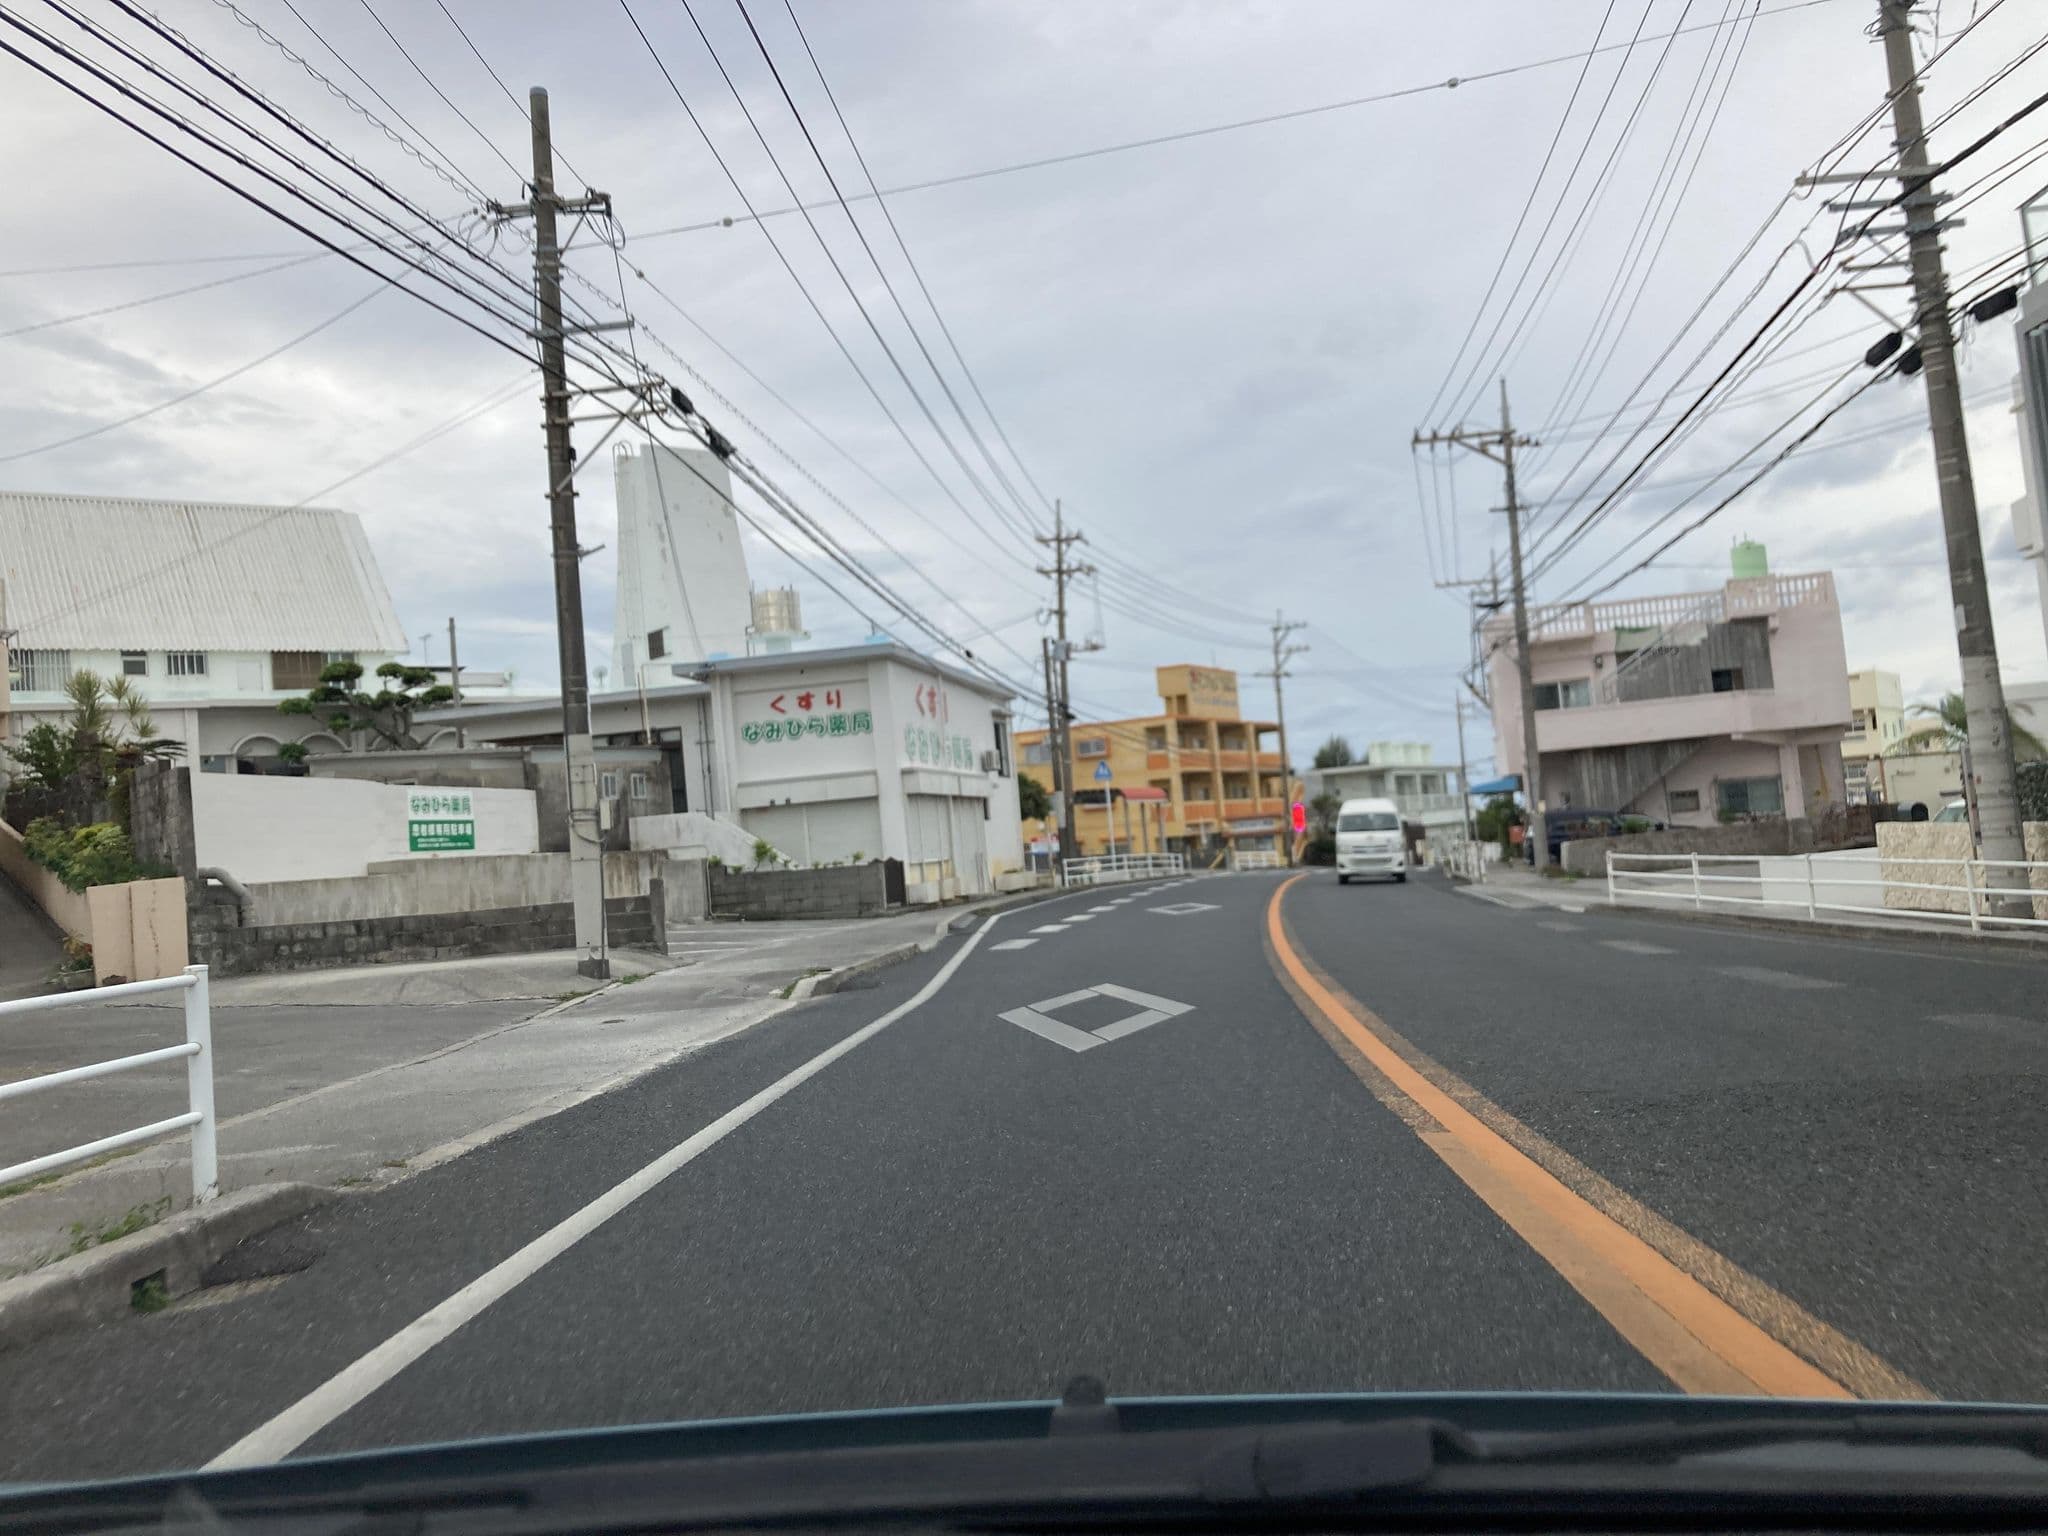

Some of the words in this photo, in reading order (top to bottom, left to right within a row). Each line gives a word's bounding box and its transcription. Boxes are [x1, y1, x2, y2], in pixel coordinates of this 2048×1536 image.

[770, 688, 842, 715] くすり
[741, 711, 873, 744] なみひら薬局
[410, 794, 471, 816] なみひら薬局
